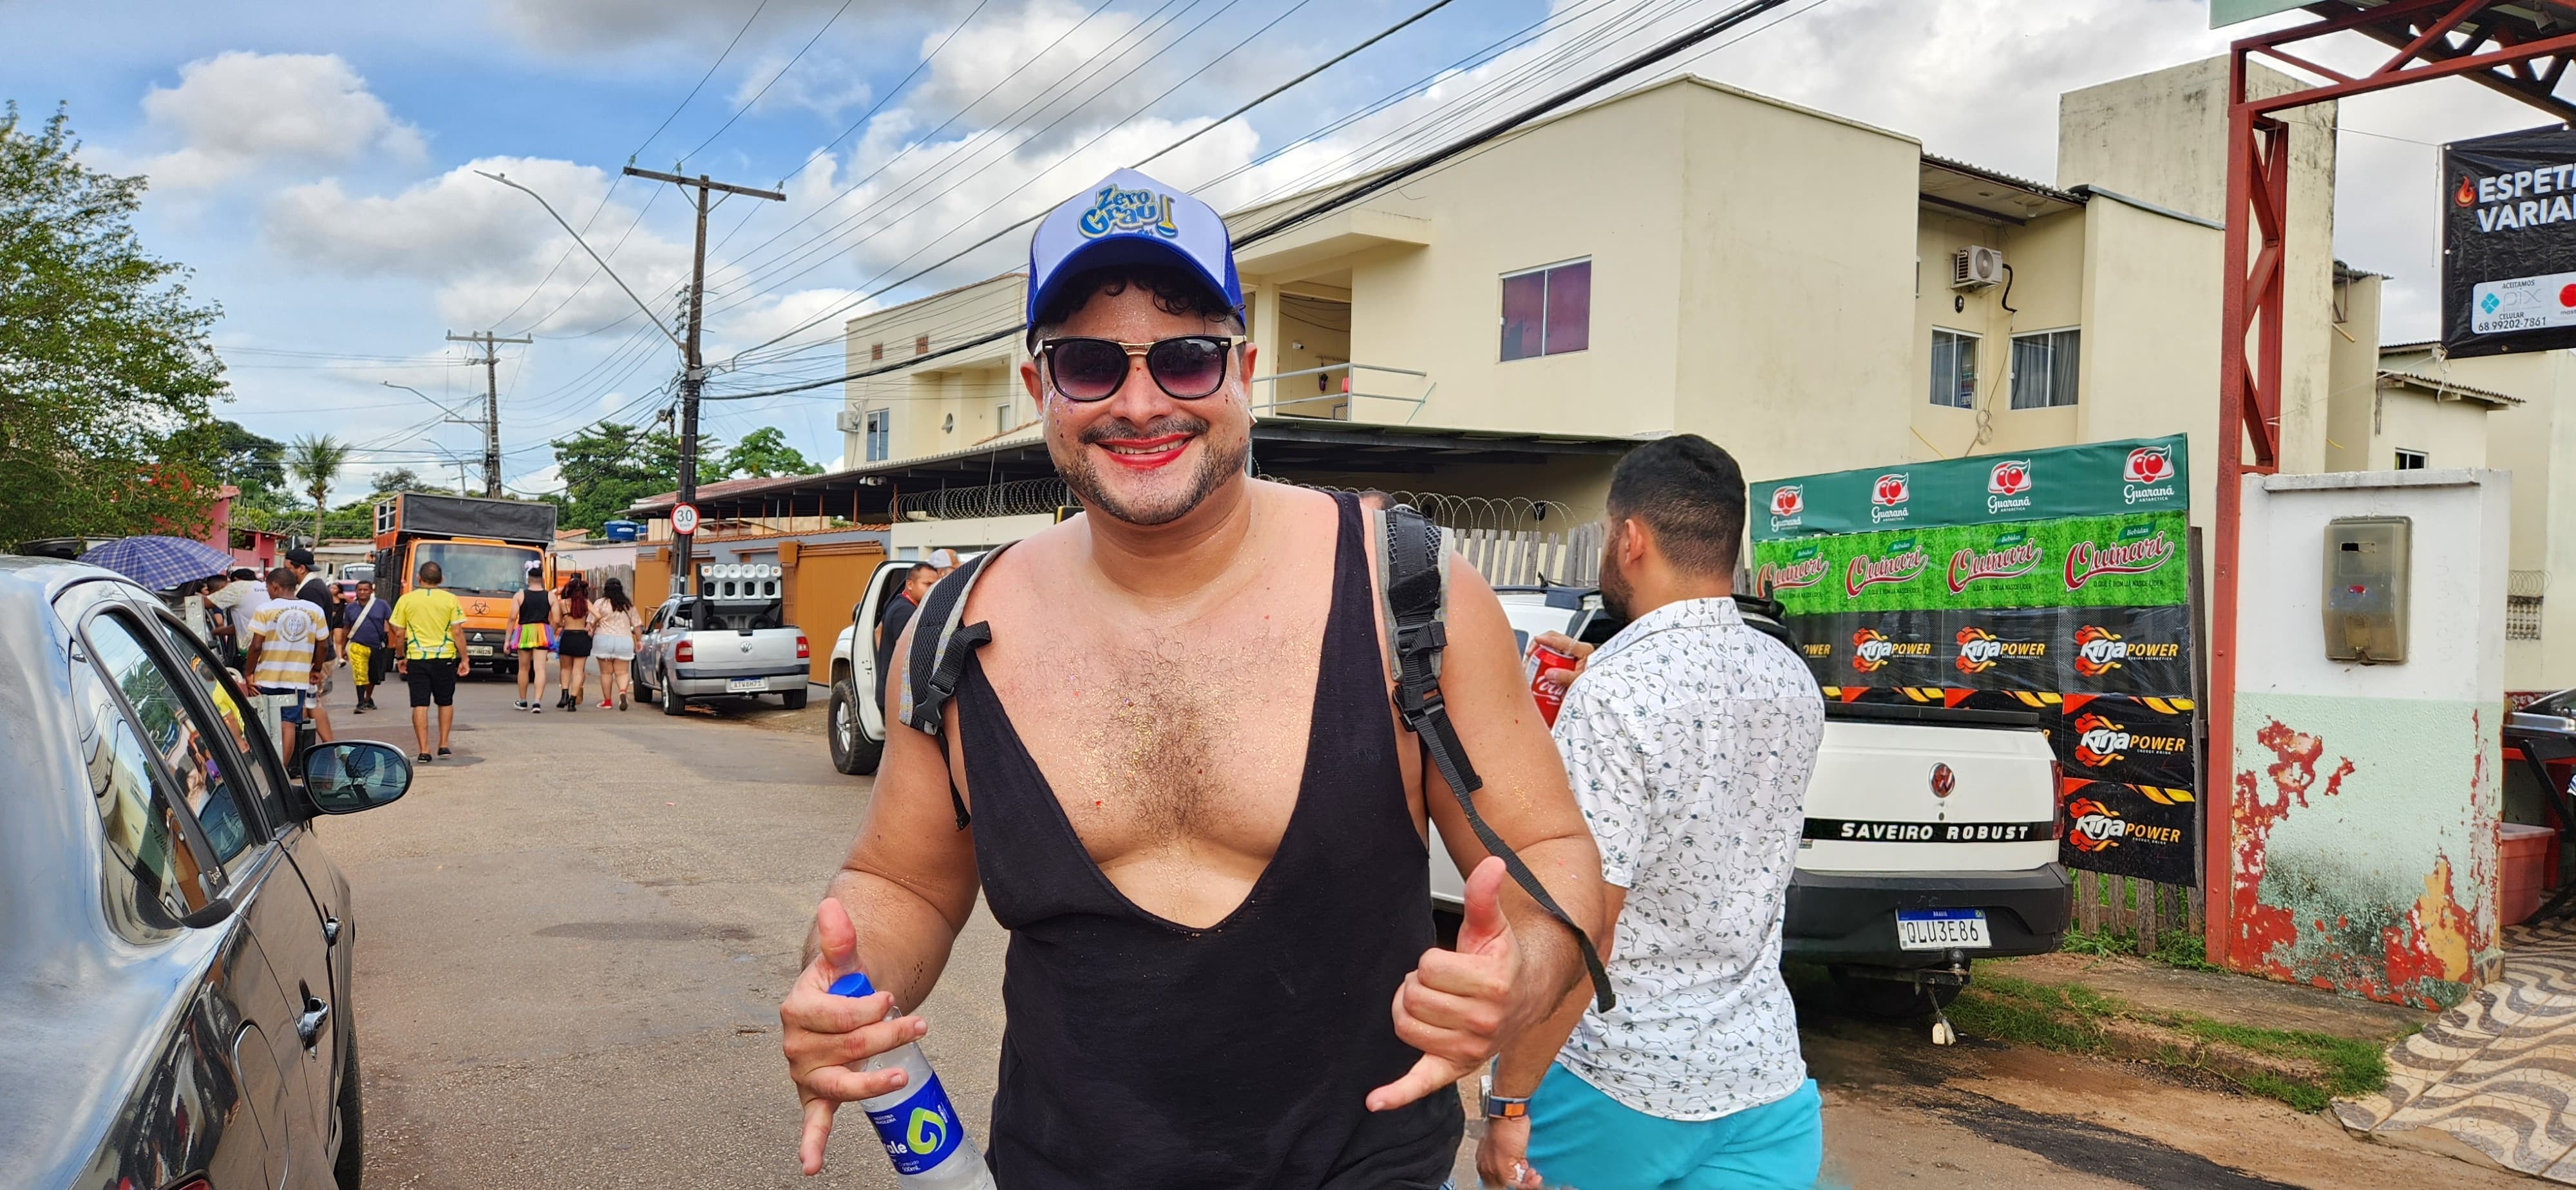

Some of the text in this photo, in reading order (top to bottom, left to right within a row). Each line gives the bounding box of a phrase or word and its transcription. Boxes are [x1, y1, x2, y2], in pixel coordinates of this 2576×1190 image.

[1096, 185, 1151, 209] Zero
[1079, 205, 1159, 236] Grau
[2501, 279, 2535, 289] ACEITAMOS
[2503, 287, 2542, 312] pix
[2478, 316, 2546, 332] 68 99202-7861
[2499, 312, 2524, 320] CELULAR
[1987, 495, 2031, 515] Guaraná
[2123, 484, 2175, 505] Guaraná
[677, 509, 693, 522] 30
[1871, 505, 1909, 524] Guaraná
[2126, 526, 2149, 536] Bebidas
[1845, 545, 1929, 600] Quinari
[1946, 537, 2043, 596] Quinari
[2063, 530, 2175, 592] Quinari
[1756, 551, 1830, 599] Quinari
[1891, 643, 1931, 655] POWER
[1960, 640, 2045, 663] Kina POWER
[2080, 639, 2179, 664] Kina POWER
[2080, 729, 2186, 755] Kina POWER
[1841, 822, 2029, 840] SAVEIRO ROBUST
[2075, 815, 2181, 843] Kina POWER
[1906, 920, 1979, 943] QLU3E86
